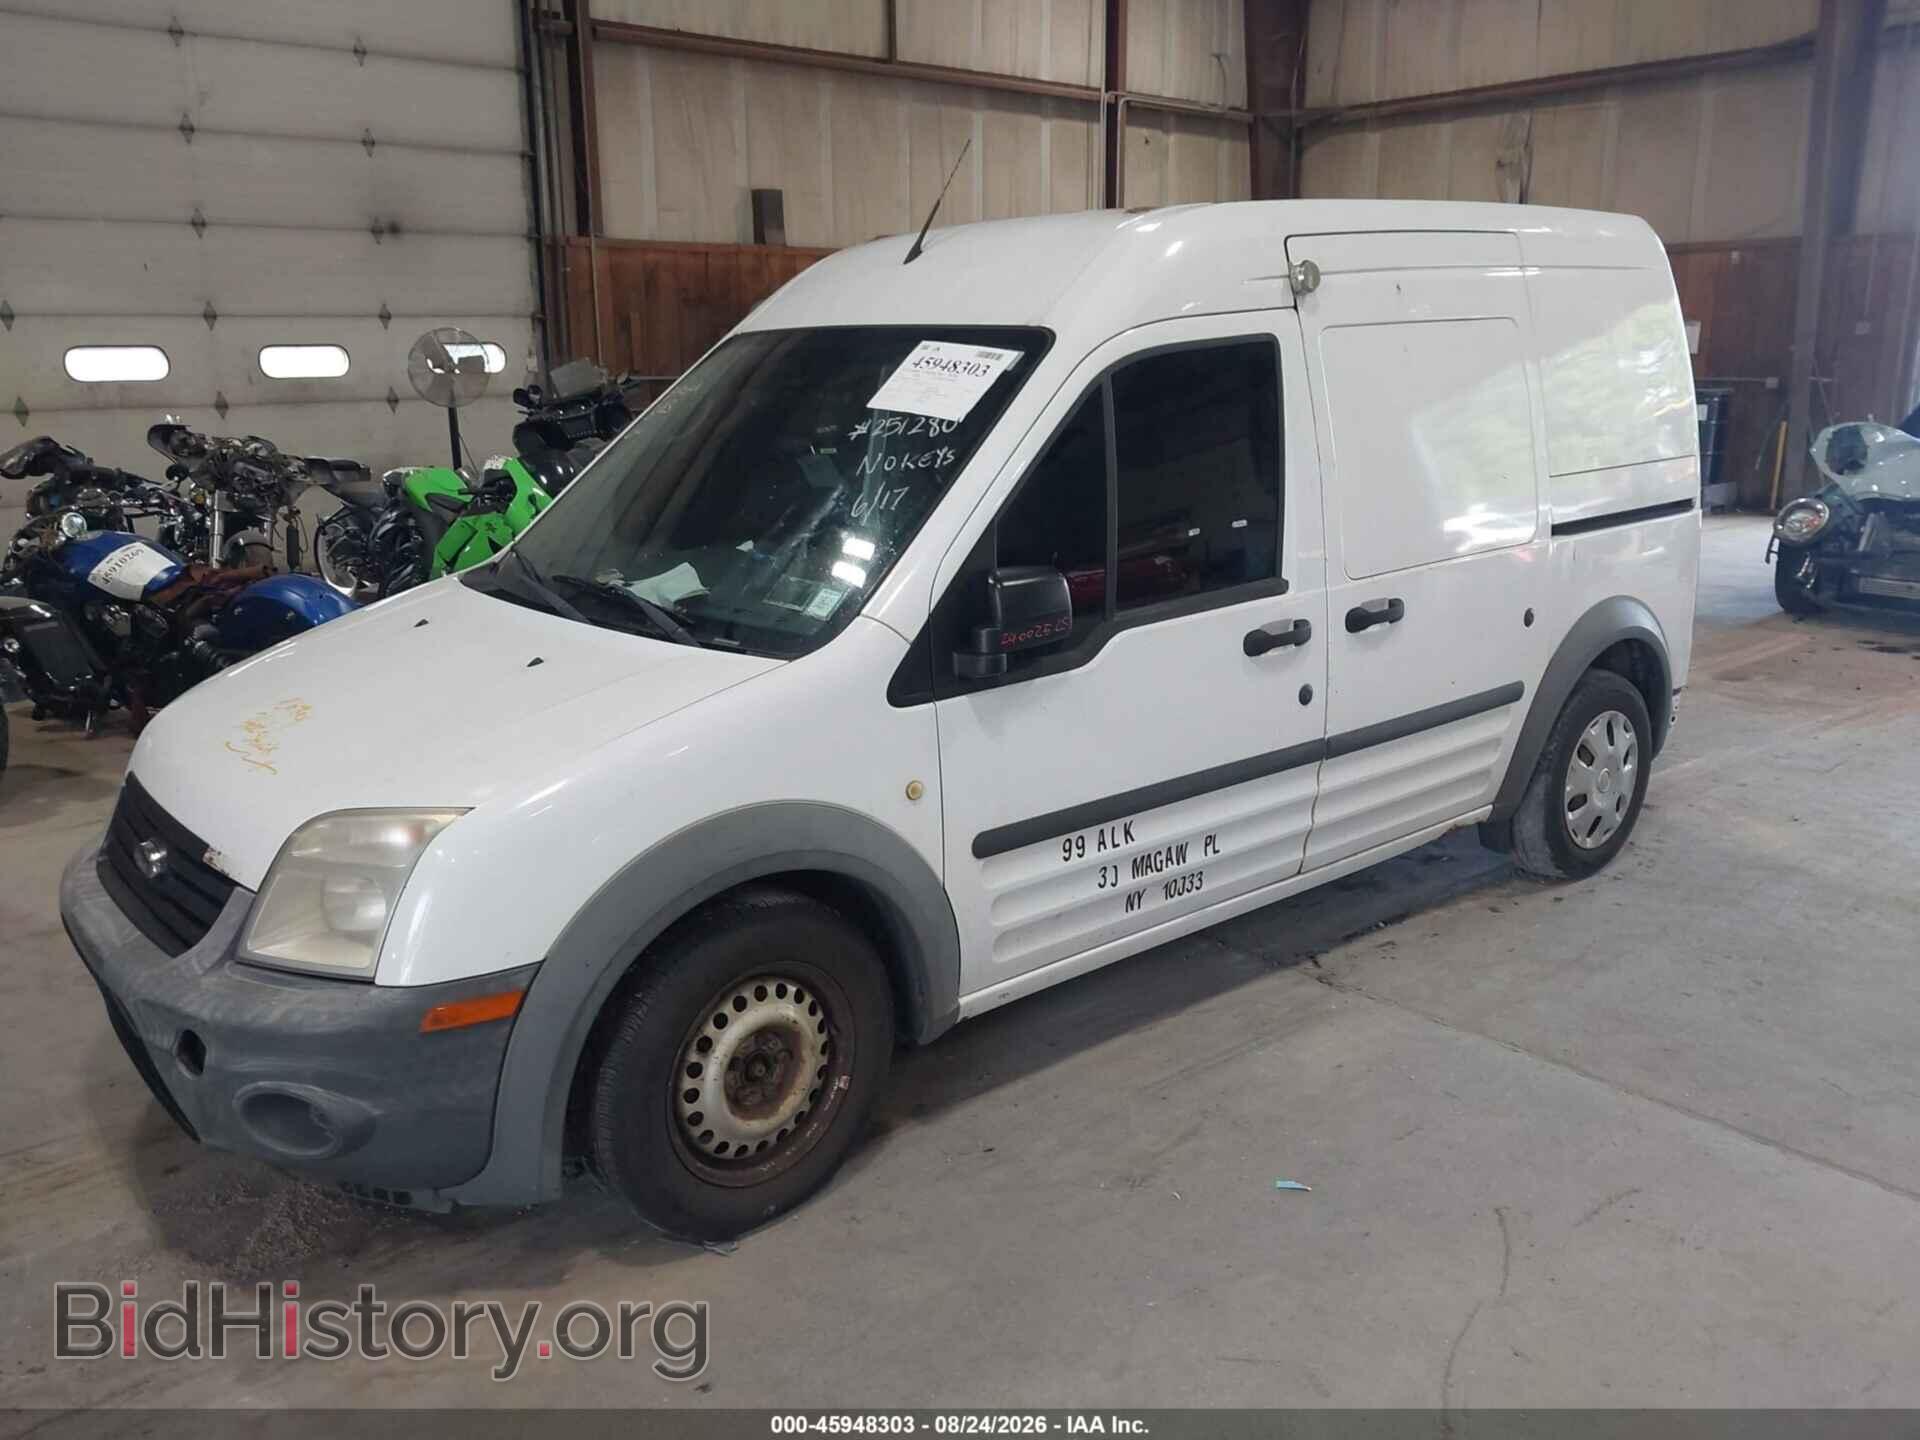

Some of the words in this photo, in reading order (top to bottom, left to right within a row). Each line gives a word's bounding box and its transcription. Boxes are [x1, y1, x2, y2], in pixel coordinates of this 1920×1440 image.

[912, 356, 991, 378] 45948303
[851, 481, 911, 526] 6/17
[1062, 835, 1085, 862] 99
[1097, 820, 1135, 852] ALK
[1131, 842, 1189, 879] MAGAW
[1204, 834, 1220, 857] PL
[1125, 888, 1147, 913] NY
